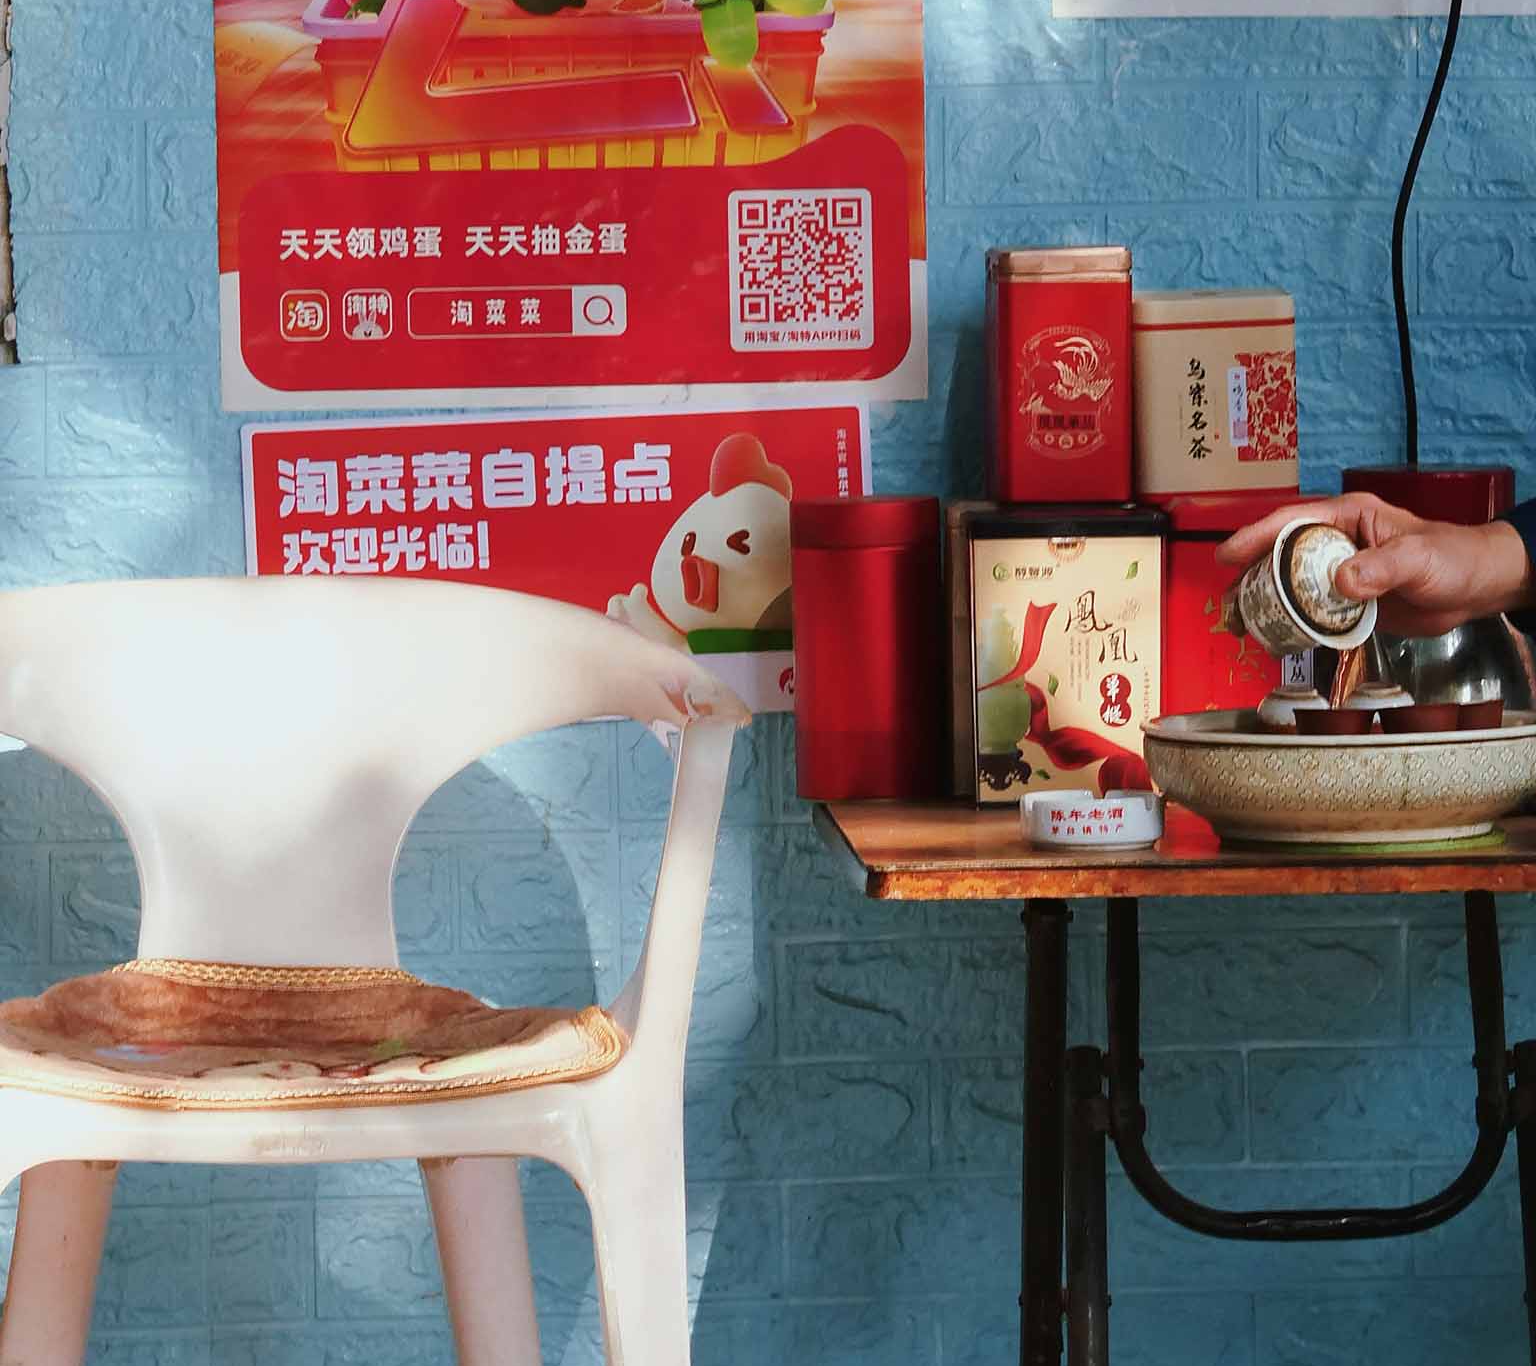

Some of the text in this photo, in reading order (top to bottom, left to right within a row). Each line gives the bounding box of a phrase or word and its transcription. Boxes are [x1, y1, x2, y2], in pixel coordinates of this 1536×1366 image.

[279, 221, 628, 260] 天天领鸡蛋 天天抽金蛋
[286, 298, 324, 332] 淘
[450, 298, 542, 327] 淘菜菜
[743, 328, 862, 345] 用淘宝/淘特APP扫码
[277, 442, 673, 517] 淘菜菜自提点
[283, 521, 491, 576] 欢迎光临!
